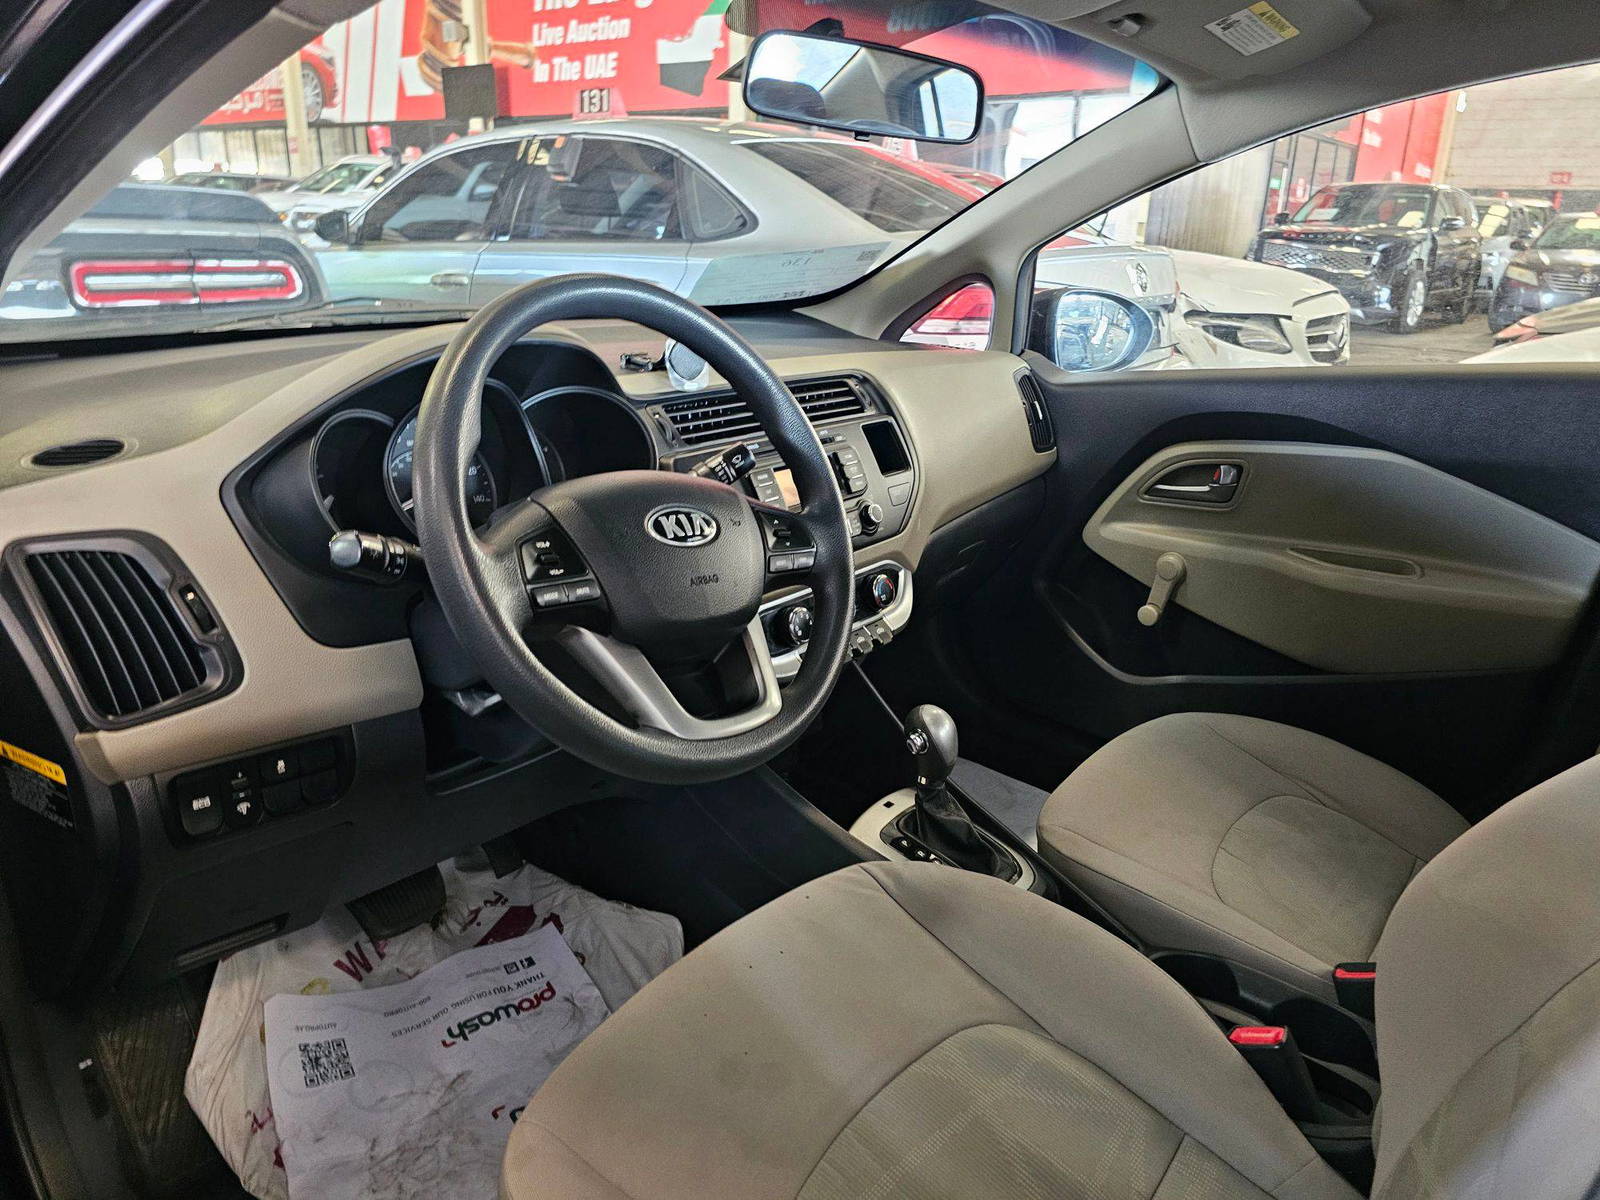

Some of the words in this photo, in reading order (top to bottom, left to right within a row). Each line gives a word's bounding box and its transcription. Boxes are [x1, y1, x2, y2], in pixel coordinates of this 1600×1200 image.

[532, 22, 565, 48] Live
[565, 15, 631, 44] Auction
[533, 59, 550, 83] In
[552, 56, 581, 82] The
[583, 51, 619, 80] UAE
[581, 88, 610, 113] 131
[658, 512, 714, 539] KIA
[690, 573, 720, 587] AIRBAG
[493, 984, 512, 996] YOU
[513, 972, 545, 989] THANK
[450, 992, 477, 1009] USING
[476, 988, 492, 999] FOR
[432, 1007, 449, 1021] OUR
[445, 981, 557, 1043] prowash
[391, 1016, 432, 1039] SERVICES
